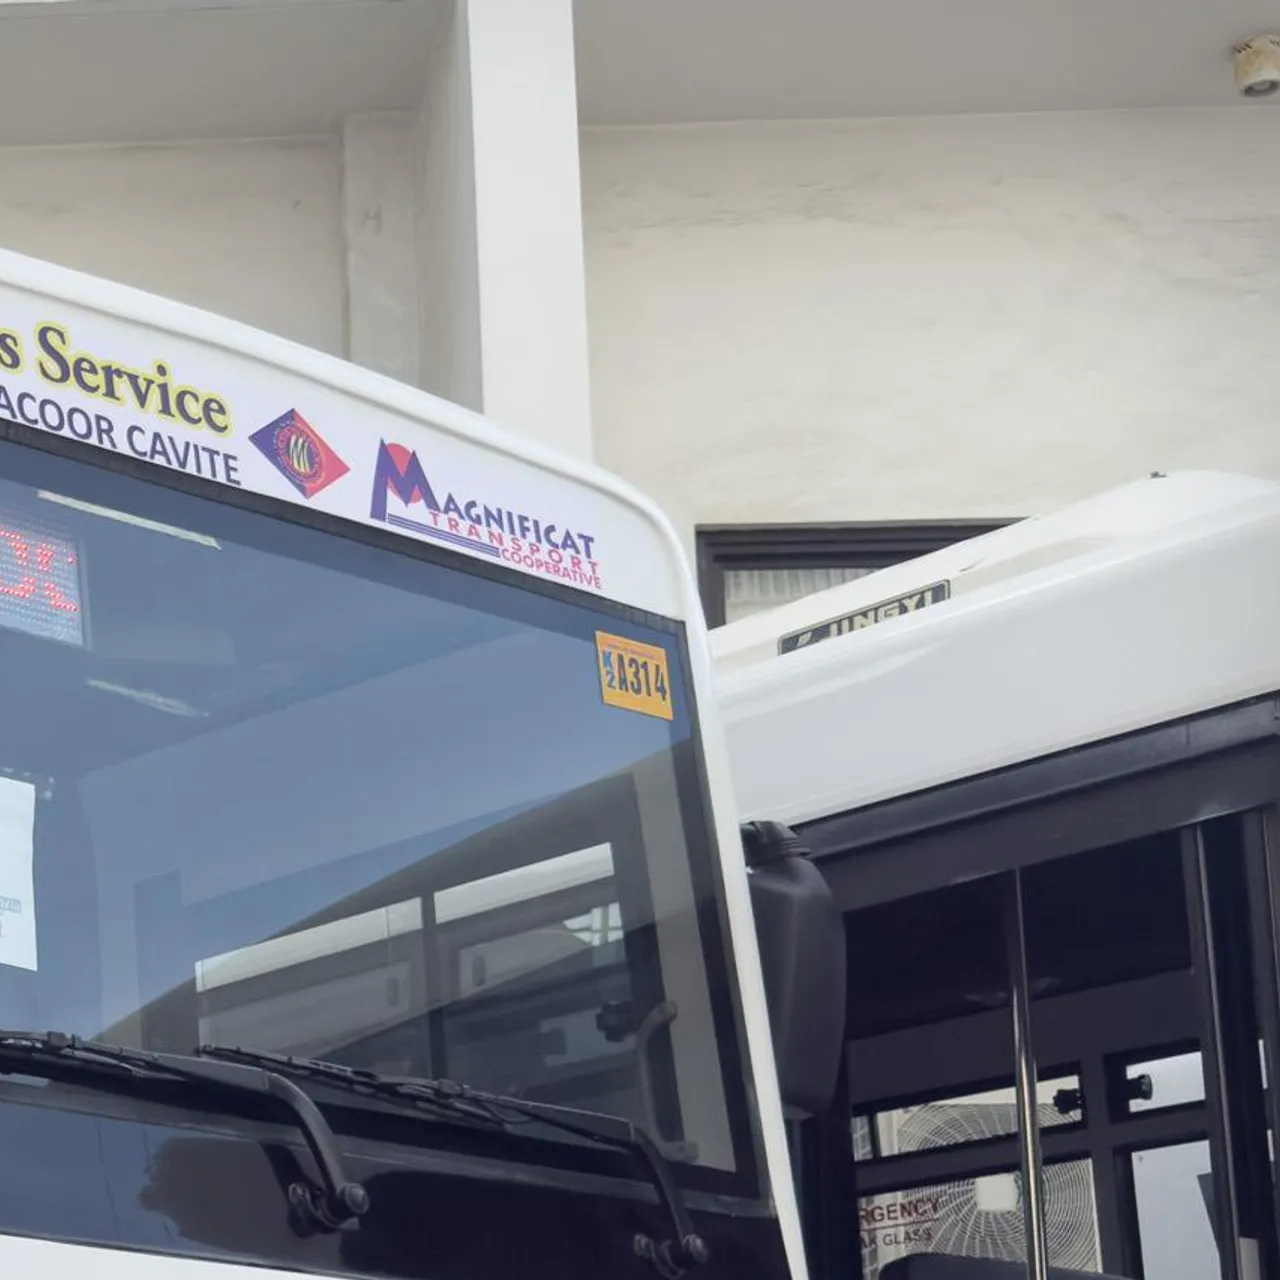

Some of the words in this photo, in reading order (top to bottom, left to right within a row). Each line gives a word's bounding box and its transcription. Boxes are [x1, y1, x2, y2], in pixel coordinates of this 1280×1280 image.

[36, 322, 233, 437] Service
[127, 424, 242, 488] CAVITE
[370, 437, 595, 560] MAGNIFICAT
[428, 510, 600, 576] TRANSPORT
[500, 547, 602, 590] COOPERATIVE
[617, 653, 667, 701] A314
[883, 1226, 932, 1246] GLASS
